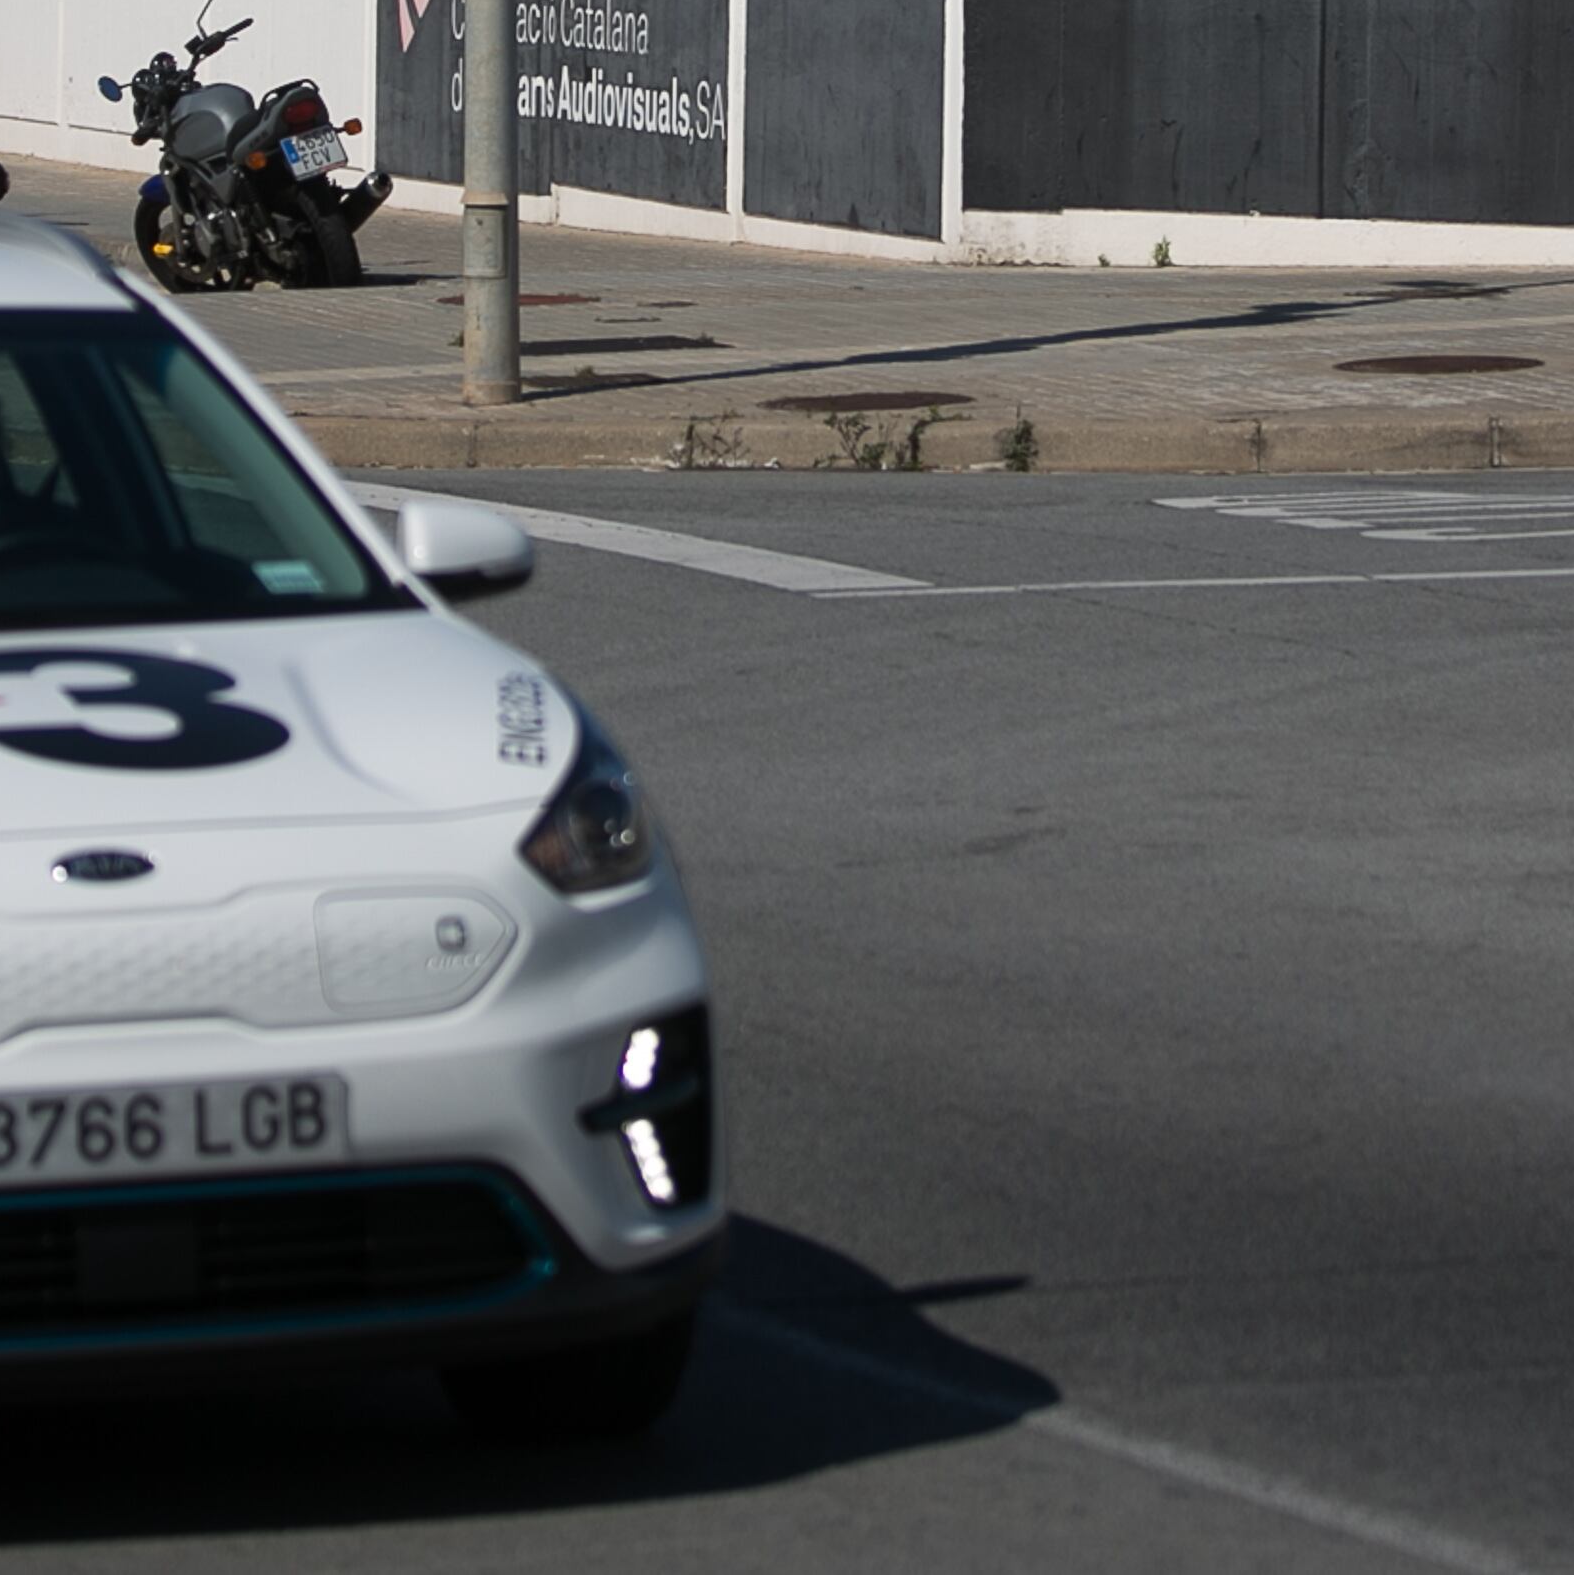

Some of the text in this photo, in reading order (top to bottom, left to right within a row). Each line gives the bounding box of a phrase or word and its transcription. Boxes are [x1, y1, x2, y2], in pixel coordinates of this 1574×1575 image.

[557, 64, 694, 145] Audiovisuals,
[696, 80, 726, 141] SA
[192, 1079, 328, 1157] LGB
